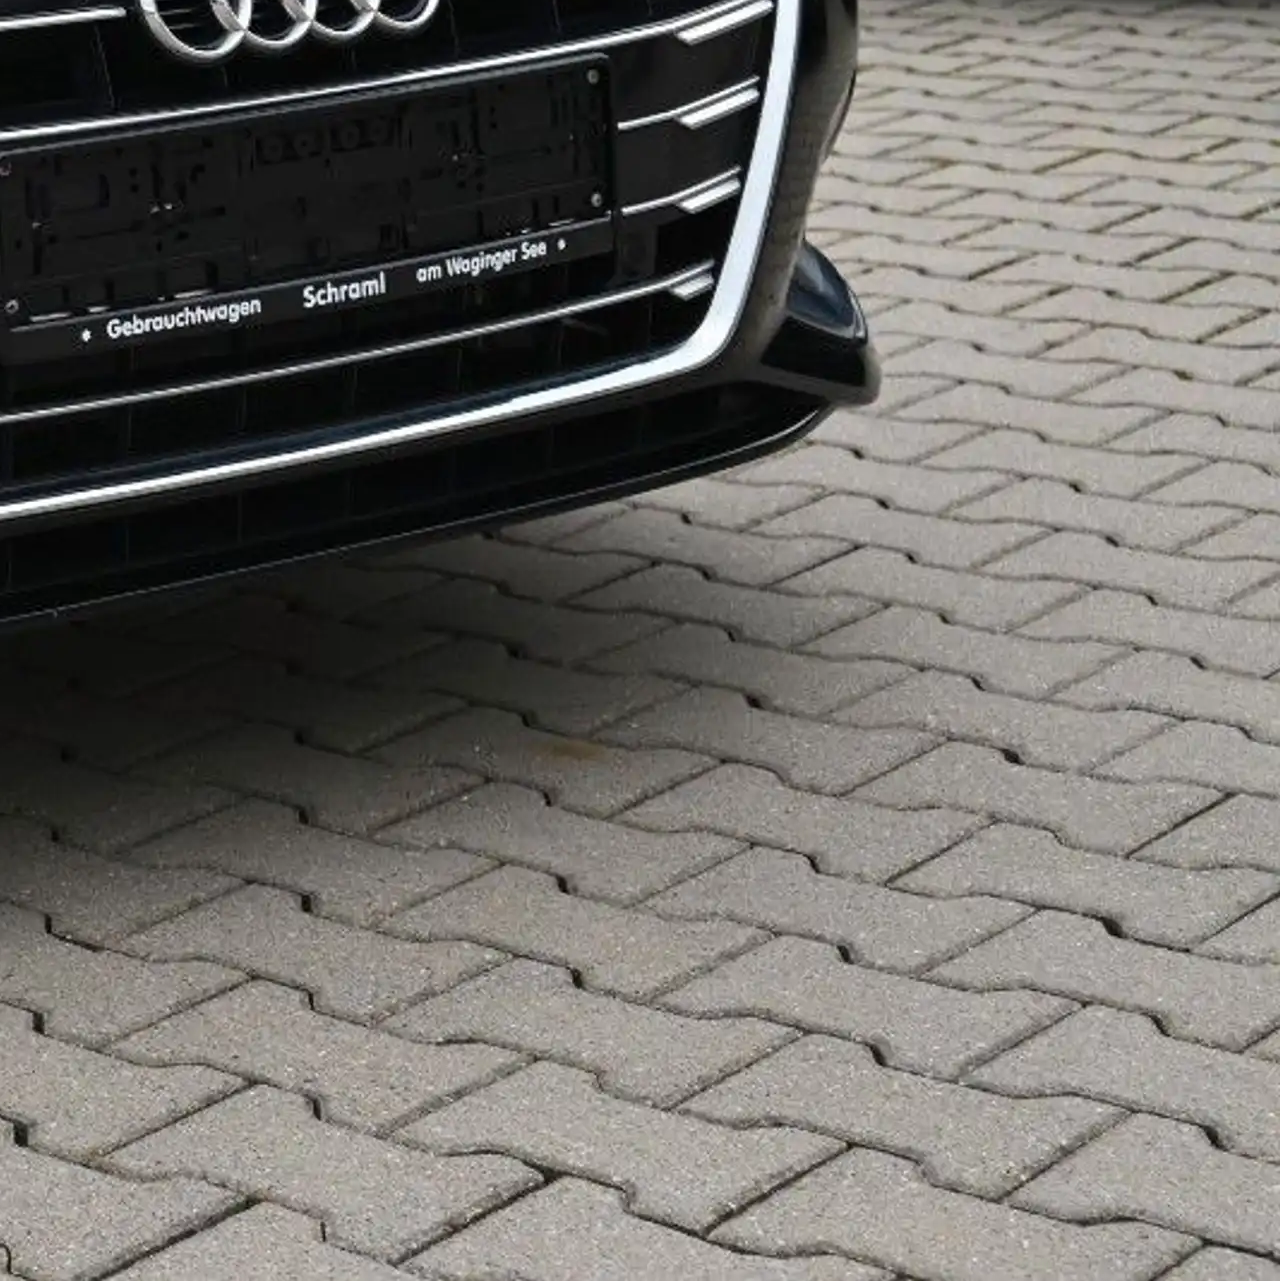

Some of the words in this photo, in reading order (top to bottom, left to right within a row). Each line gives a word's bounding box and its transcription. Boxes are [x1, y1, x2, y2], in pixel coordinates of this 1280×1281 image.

[106, 299, 262, 339] Gebrauchtwagen
[303, 272, 386, 308] Schraml
[416, 265, 441, 282] am
[445, 249, 517, 277] Waginger
[521, 242, 547, 260] See
